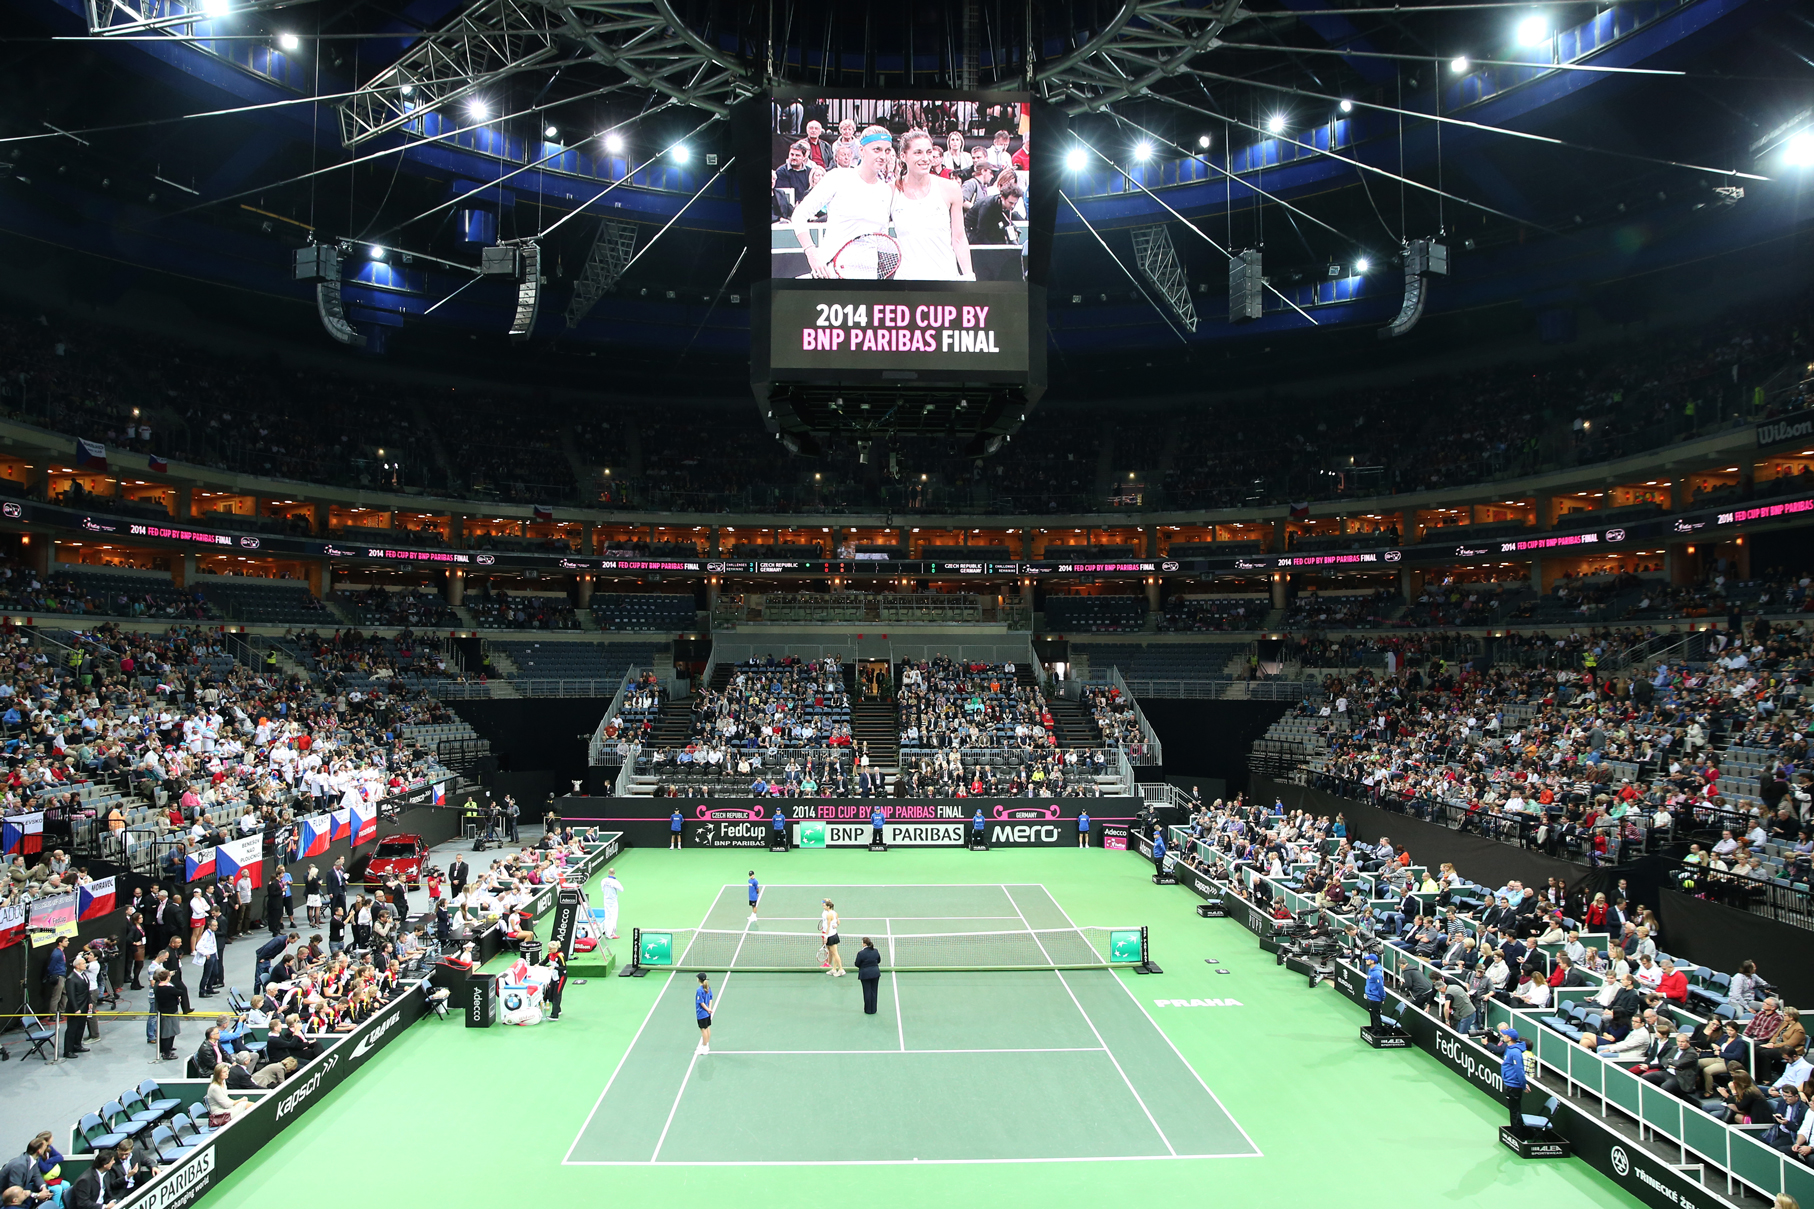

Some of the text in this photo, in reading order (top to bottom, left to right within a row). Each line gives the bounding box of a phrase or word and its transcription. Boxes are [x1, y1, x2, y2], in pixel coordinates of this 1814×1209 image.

[816, 304, 989, 328] 2014 FED CUP BY
[803, 329, 999, 352] BNP PARIBAS FINAL
[1758, 420, 1813, 444] Wilson
[1718, 500, 1814, 524] 2014 FED CUP BY BNP PARIBAS
[130, 525, 232, 545] 2014 FED CUP BY BNP PARIBAS FINAL
[1501, 543, 1516, 552] 2014
[1517, 542, 1527, 550] FED
[1528, 541, 1538, 549] CUP
[1546, 539, 1557, 547] BNP
[1558, 536, 1581, 546] PARIBAS
[1582, 534, 1598, 544] FINAL
[431, 553, 453, 561] PARIBAS
[1336, 555, 1360, 563] PARIBAS
[793, 806, 964, 818] 2014 FED CUP BY NP PARIBAS FINAL
[721, 823, 765, 840] FedCup
[831, 827, 962, 842] BNP PARIBAS
[1194, 878, 1210, 895] kapsch
[557, 908, 570, 941] Adecco
[473, 987, 482, 1021] Adecco
[1153, 998, 1244, 1007] PRAHA
[368, 1011, 400, 1044] TRAVEL
[1436, 1030, 1503, 1092] FedCup.com
[276, 1072, 321, 1121] kapsch
[161, 1154, 209, 1205] PARIBAS
[195, 1175, 210, 1193] world
